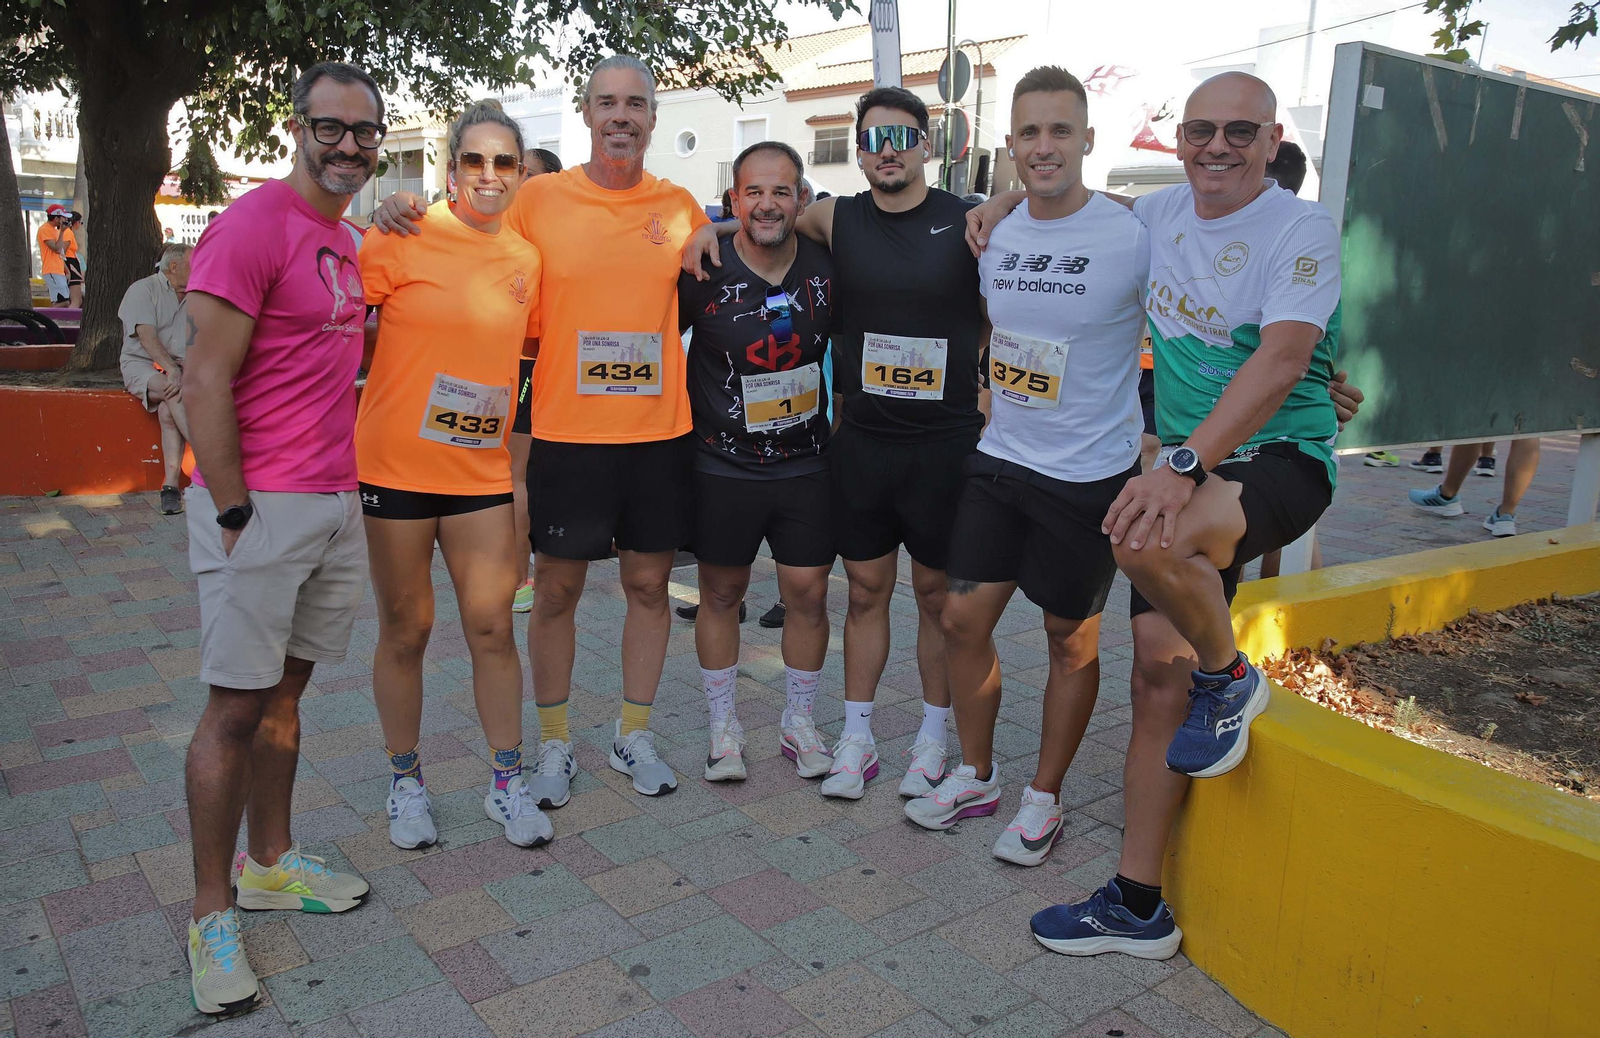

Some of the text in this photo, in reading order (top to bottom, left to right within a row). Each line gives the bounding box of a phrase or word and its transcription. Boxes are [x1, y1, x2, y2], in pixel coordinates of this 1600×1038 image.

[992, 277, 1086, 295] new balance
[1208, 327, 1230, 338] TRAIL
[588, 363, 652, 380] 434
[874, 365, 934, 386] 164
[994, 361, 1050, 393] 375
[437, 383, 447, 392] POR
[447, 386, 458, 394] UNA
[457, 388, 477, 399] SONRISA
[519, 376, 530, 403] SCOTT
[779, 399, 792, 413] 1
[435, 411, 500, 434] 433
